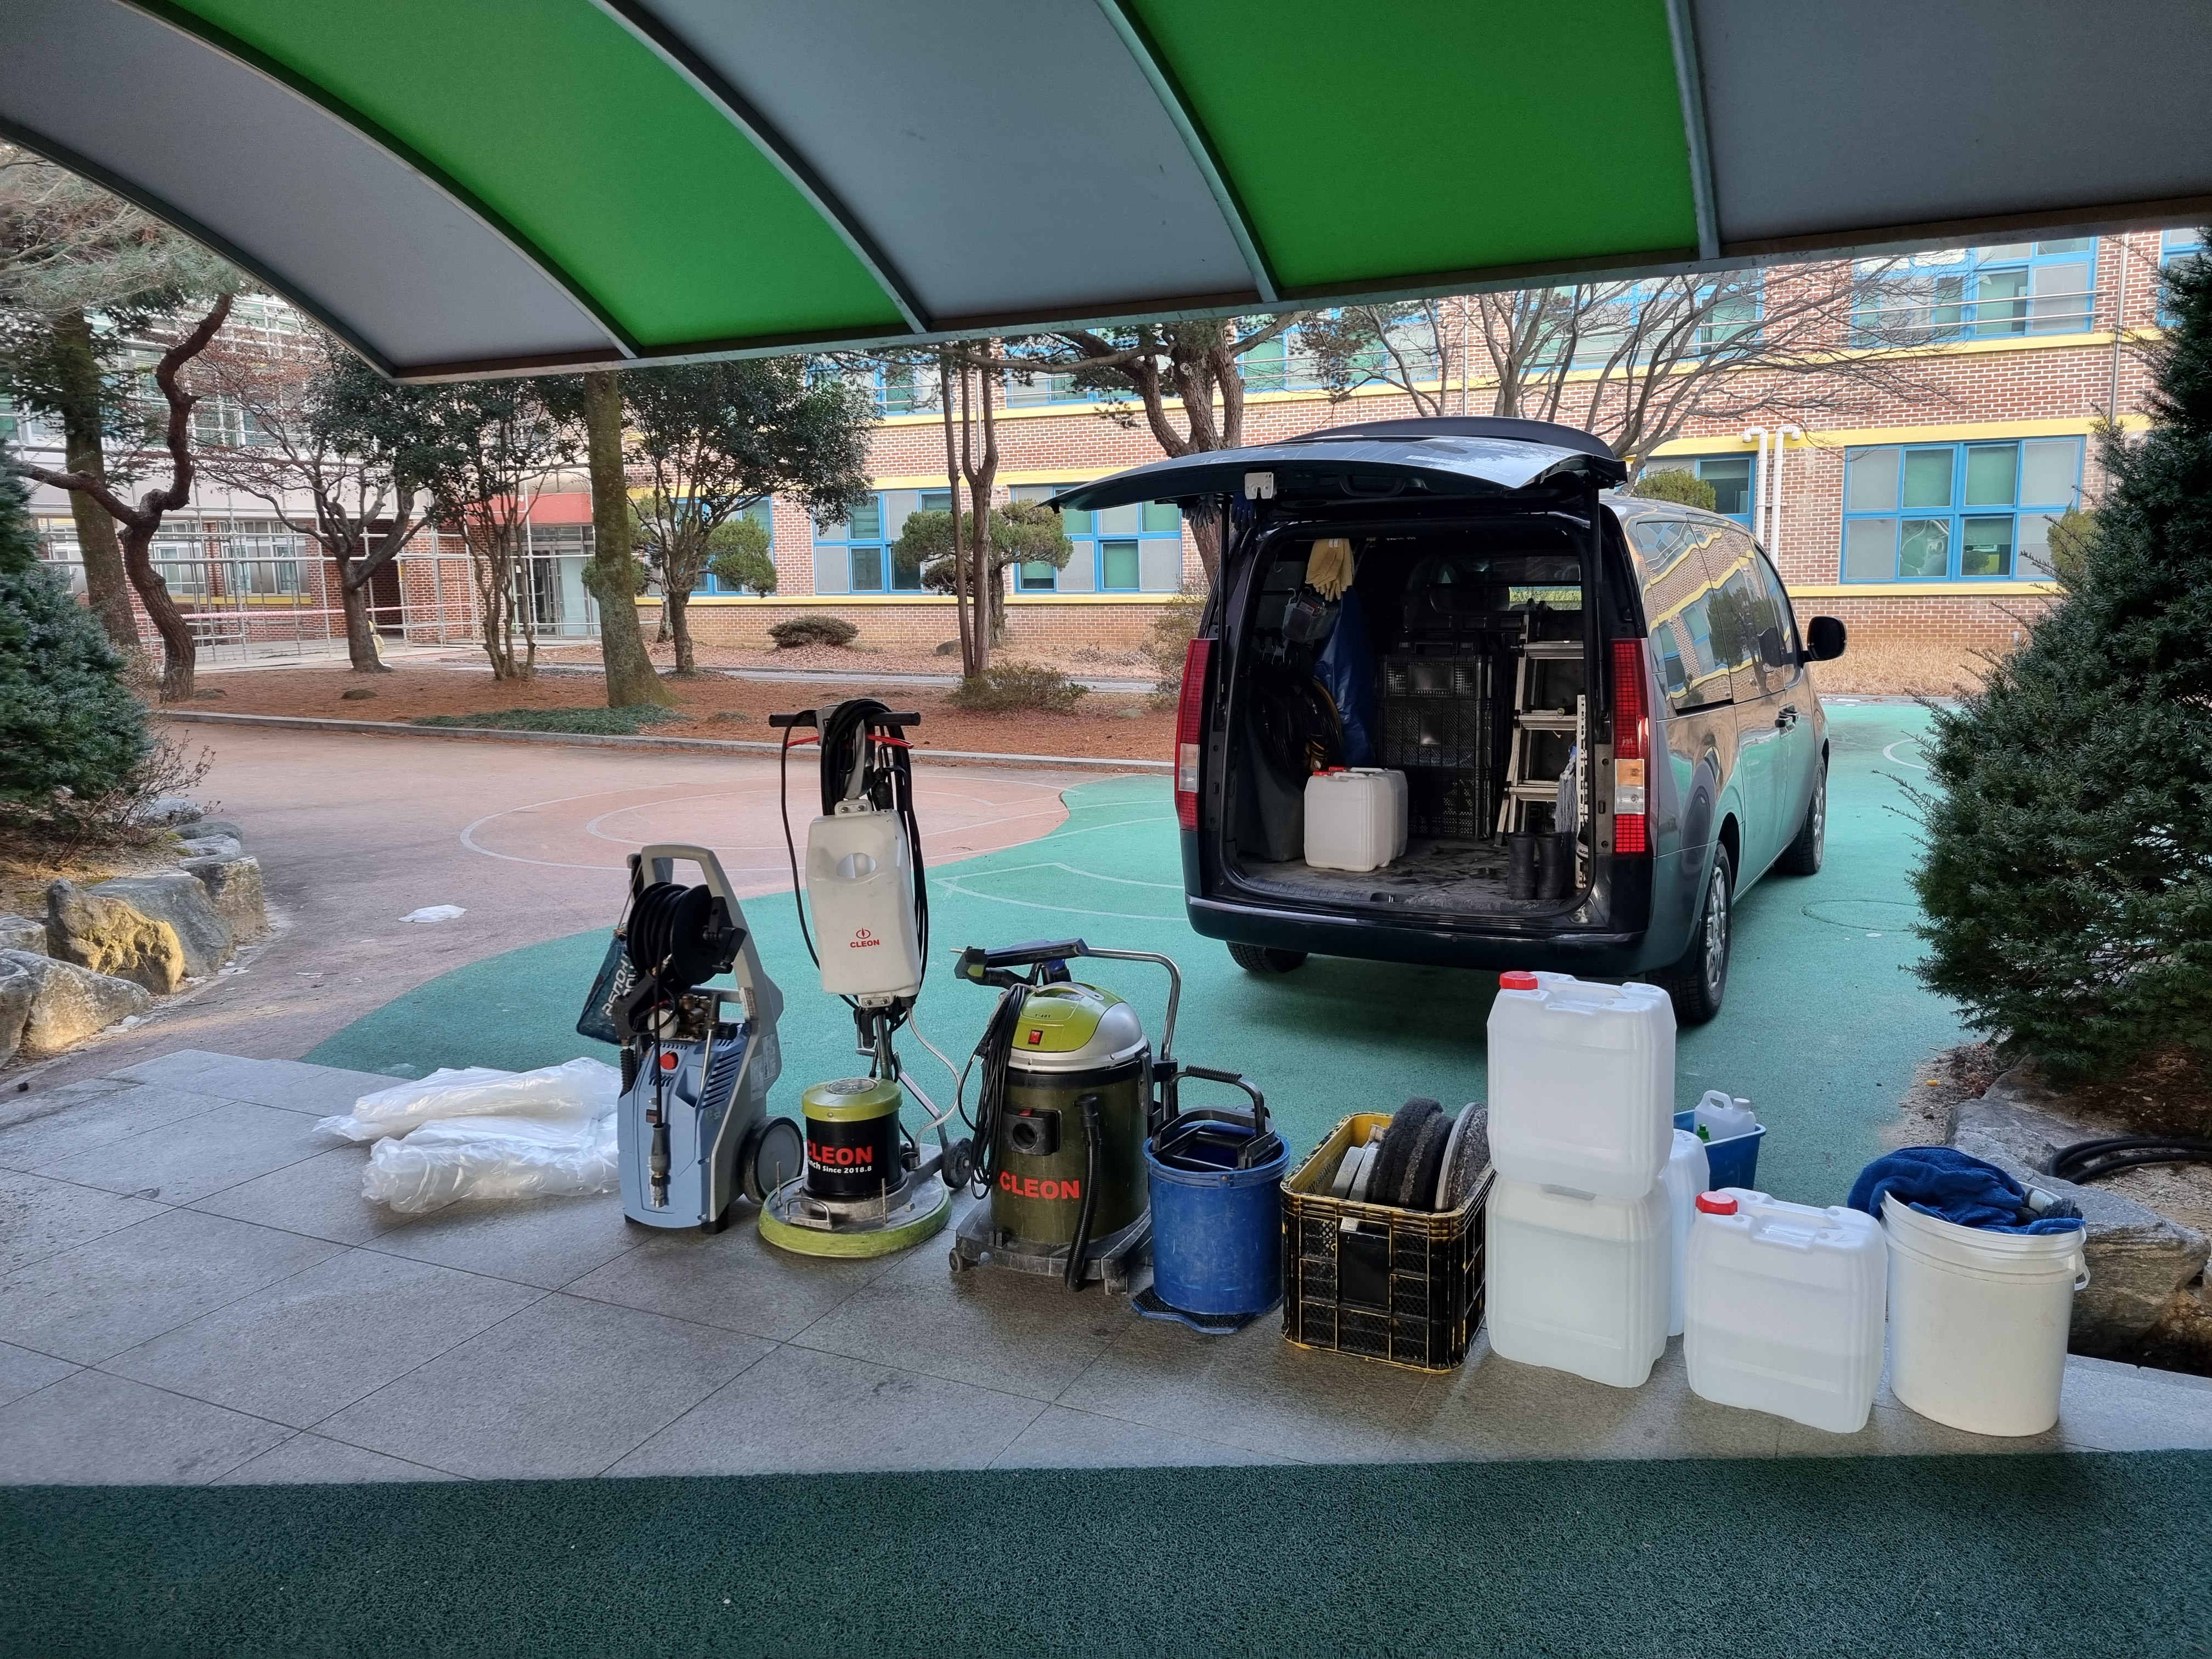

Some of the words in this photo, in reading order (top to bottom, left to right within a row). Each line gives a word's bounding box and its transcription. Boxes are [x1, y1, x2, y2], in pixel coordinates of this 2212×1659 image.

[850, 939, 880, 948] CLEON
[822, 1165, 842, 1173] Since
[1000, 1171, 1080, 1199] CLEON
